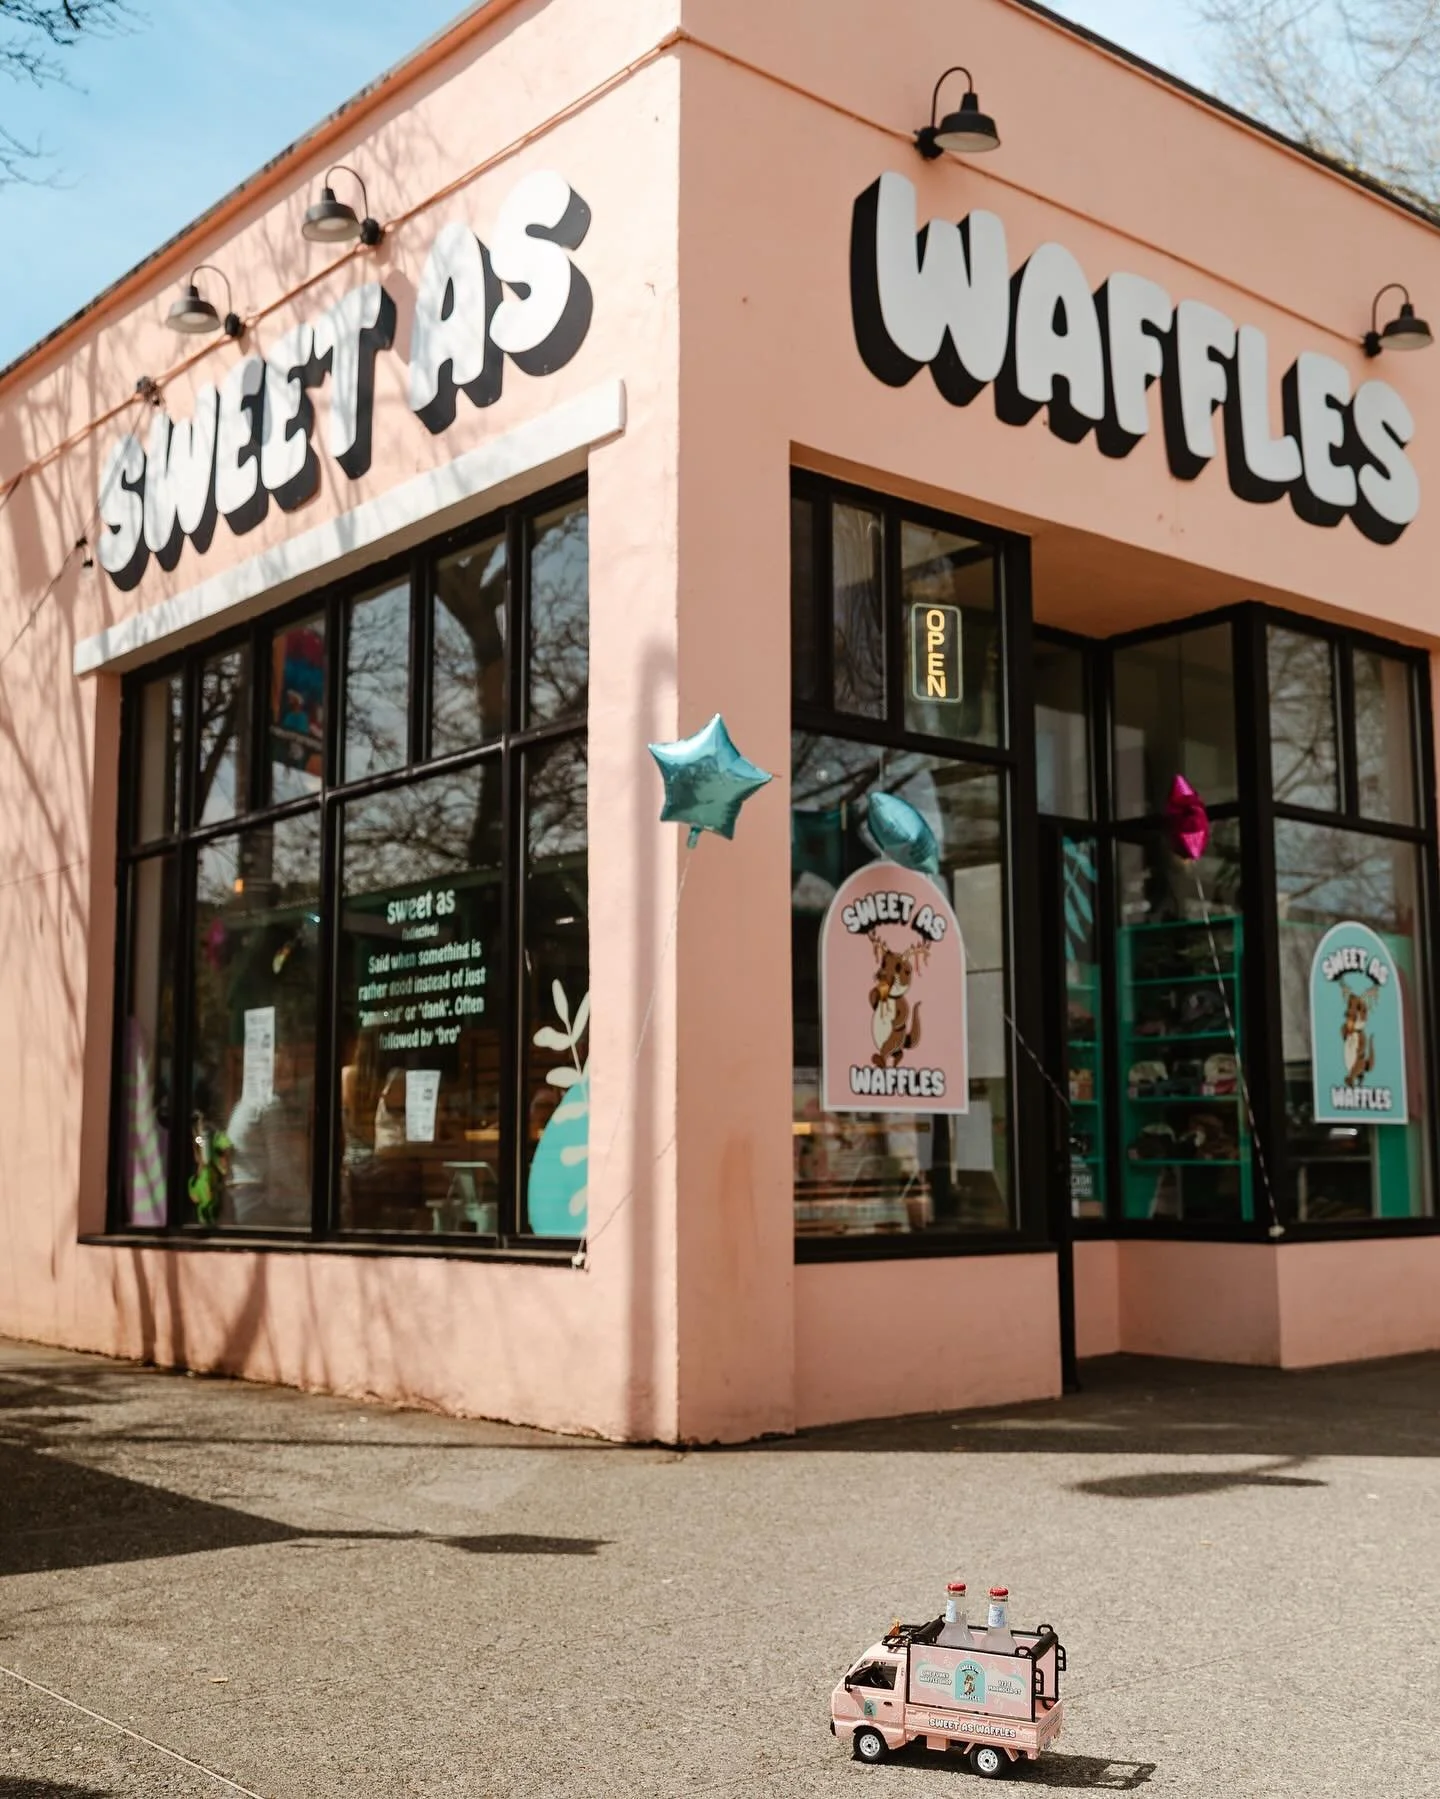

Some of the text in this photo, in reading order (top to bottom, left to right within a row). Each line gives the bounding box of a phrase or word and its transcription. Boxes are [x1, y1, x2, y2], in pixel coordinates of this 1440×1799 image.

[849, 171, 1420, 545] WAFFLES
[100, 170, 593, 591] SWEET AS
[926, 609, 947, 698] OPEN
[387, 889, 455, 925] sweet as
[841, 892, 946, 942] SWEET AS
[368, 938, 482, 974] Said when something is
[1322, 947, 1368, 981] SWEET
[358, 981, 388, 1001] rather
[414, 971, 450, 994] instead
[452, 967, 464, 988] of
[405, 1006, 417, 1022] or
[455, 996, 485, 1016] Often
[380, 1028, 420, 1050] followed
[420, 1027, 434, 1047] by
[850, 1065, 946, 1097] WAFFLES
[1331, 1086, 1393, 1110] WAFFLES
[929, 1718, 1017, 1738] SWEET AS WAFFLES
